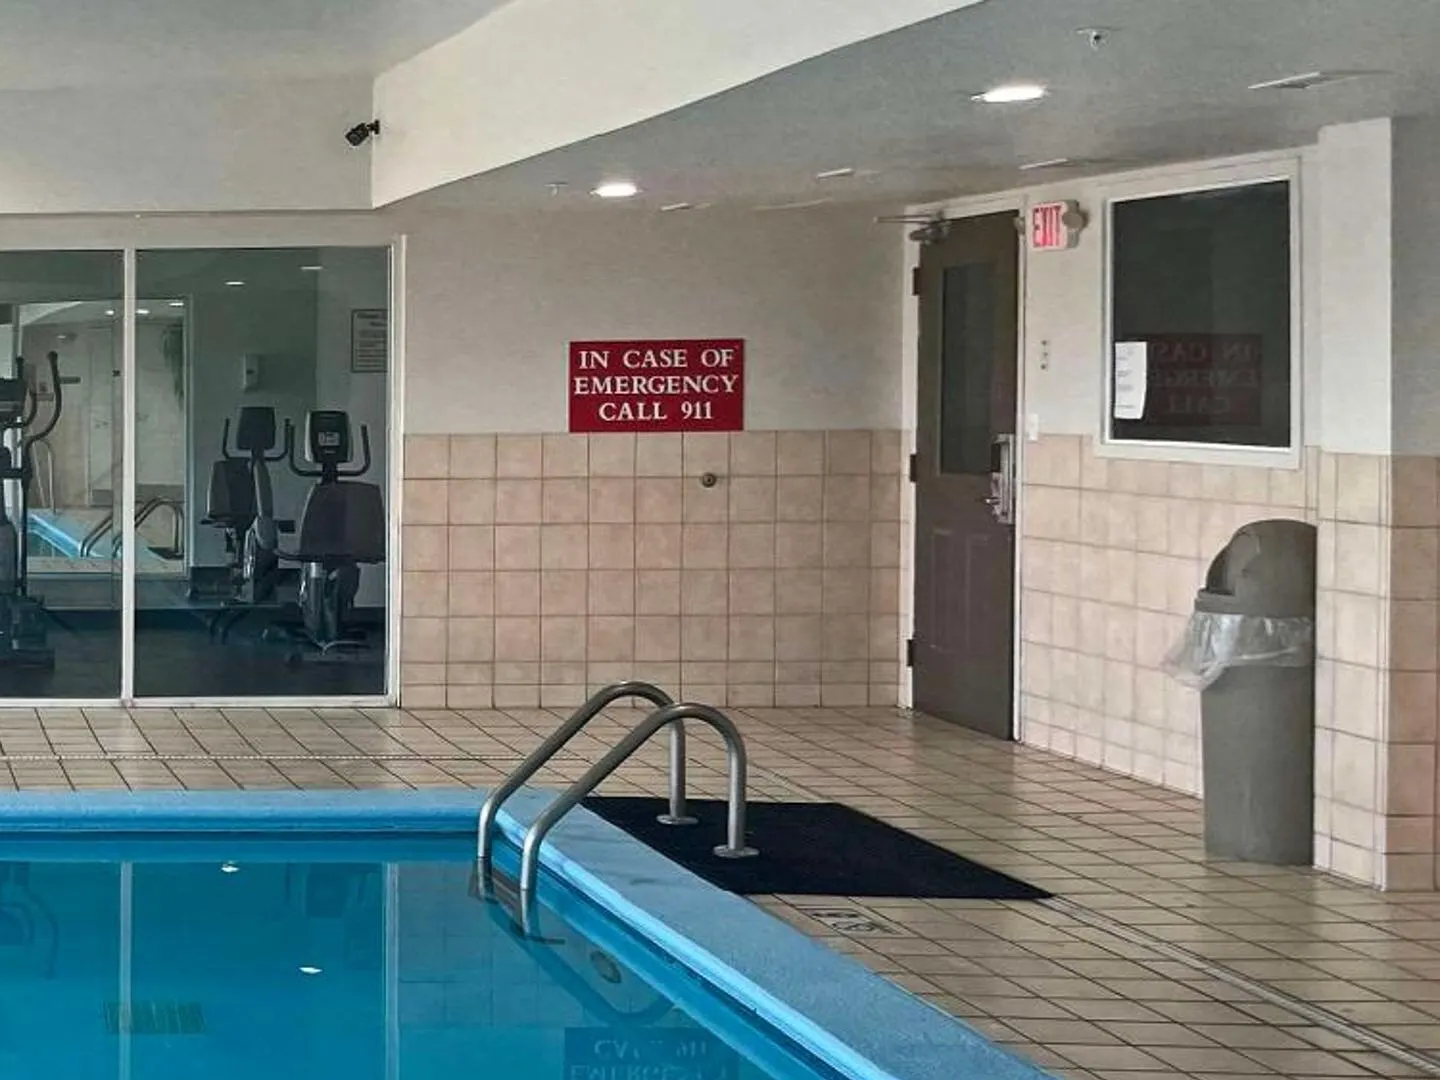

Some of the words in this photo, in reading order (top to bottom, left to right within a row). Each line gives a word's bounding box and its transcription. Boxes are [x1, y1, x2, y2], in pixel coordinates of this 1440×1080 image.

[1033, 206, 1061, 247] EXIT
[579, 351, 610, 369] IN
[623, 349, 688, 368] CASE
[701, 349, 734, 367] OF
[574, 375, 739, 394] EMERGENCY
[599, 402, 667, 421] CALL
[681, 401, 712, 419] 911
